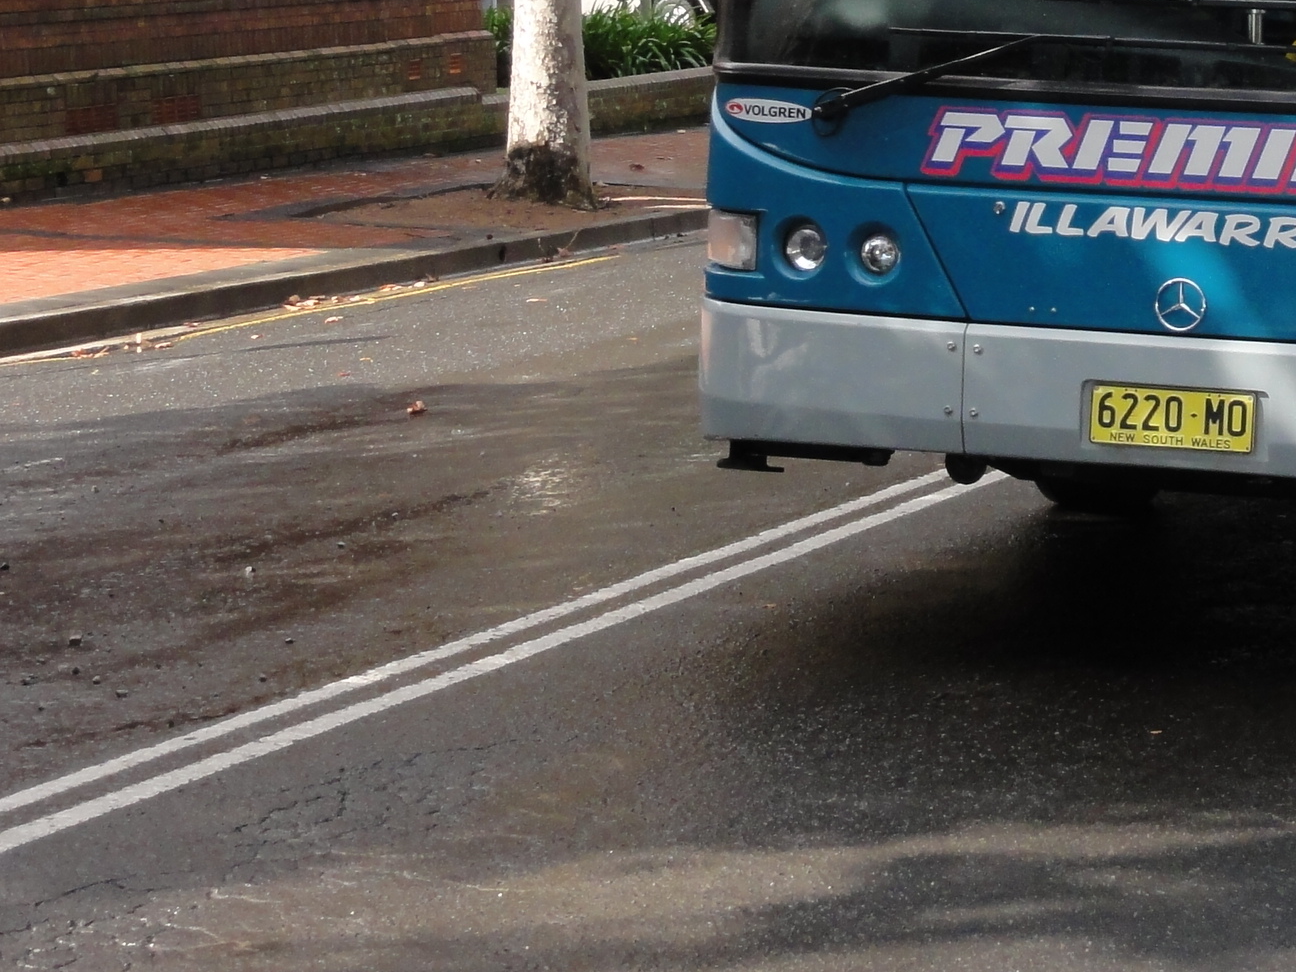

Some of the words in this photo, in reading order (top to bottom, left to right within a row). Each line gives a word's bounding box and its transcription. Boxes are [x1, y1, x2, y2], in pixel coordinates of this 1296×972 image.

[744, 104, 806, 119] VOLGREN
[1109, 432, 1136, 443] NEW
[1143, 434, 1184, 446] SOUTH
[1191, 437, 1231, 449] WALES
